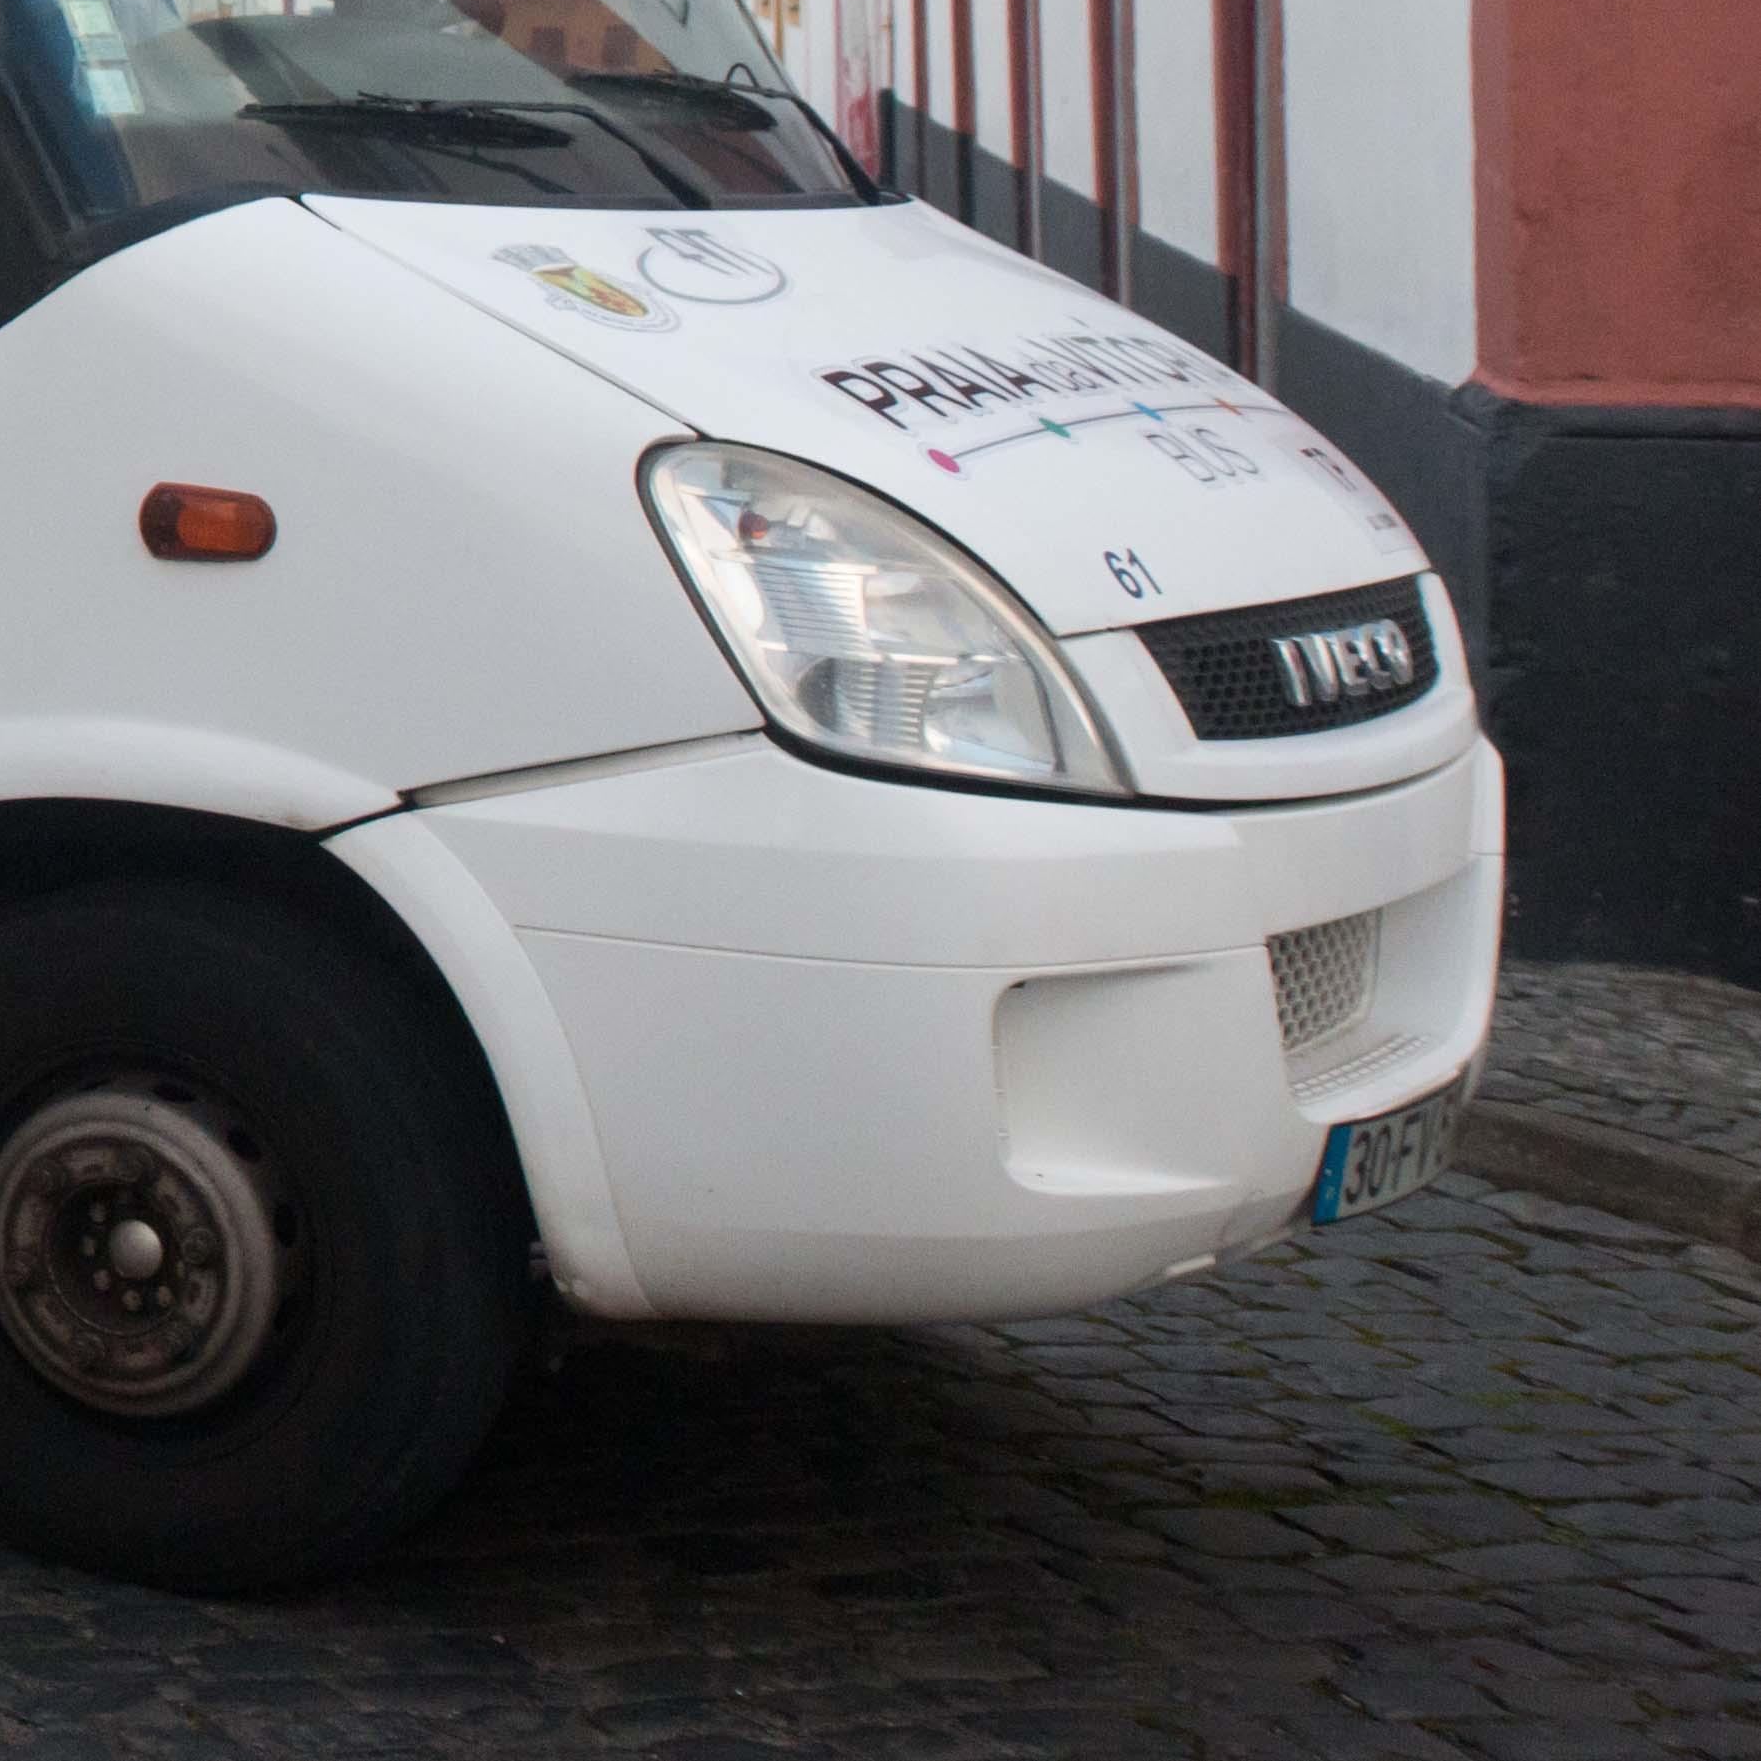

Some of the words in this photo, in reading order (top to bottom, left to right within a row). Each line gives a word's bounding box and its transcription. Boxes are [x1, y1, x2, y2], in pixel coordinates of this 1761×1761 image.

[820, 345, 1059, 431] PRAIA
[1145, 427, 1260, 483] BUS
[1103, 547, 1163, 600] 61
[1270, 618, 1415, 707] IVECO
